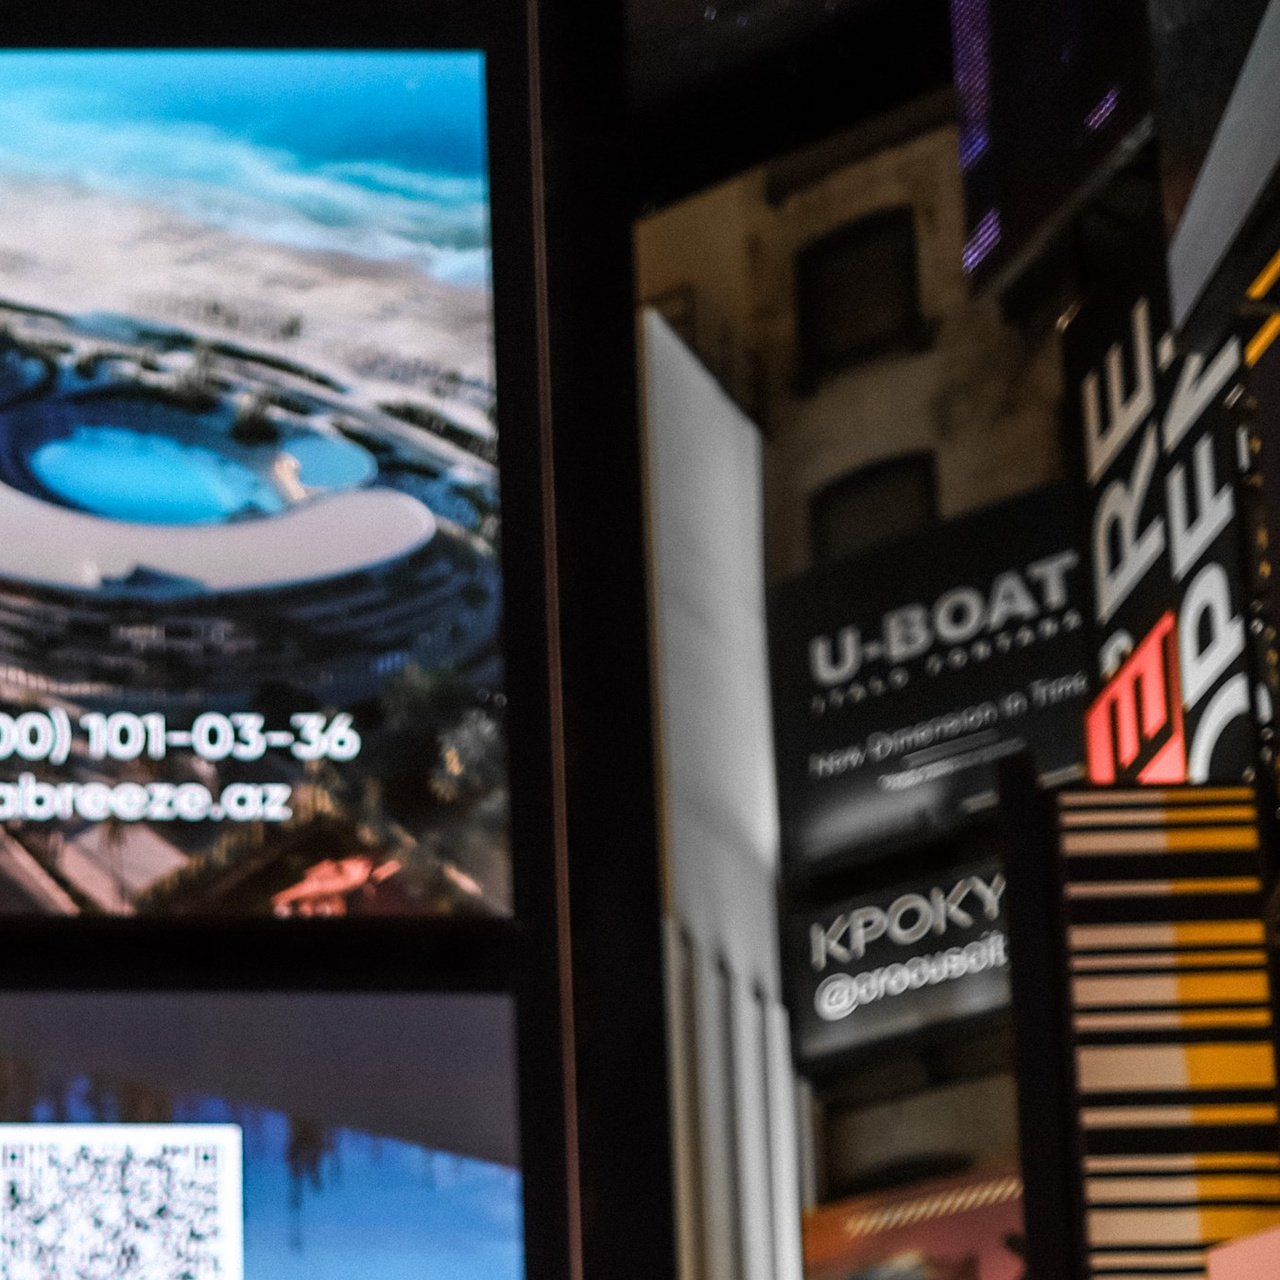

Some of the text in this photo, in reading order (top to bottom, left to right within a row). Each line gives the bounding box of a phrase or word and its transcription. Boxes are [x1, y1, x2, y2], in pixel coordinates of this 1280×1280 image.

[809, 549, 1081, 688] U-BOAT
[80, 711, 362, 761] 101-03-36
[809, 745, 866, 778] New
[866, 701, 998, 761] Dimension
[1031, 669, 1089, 707] Time
